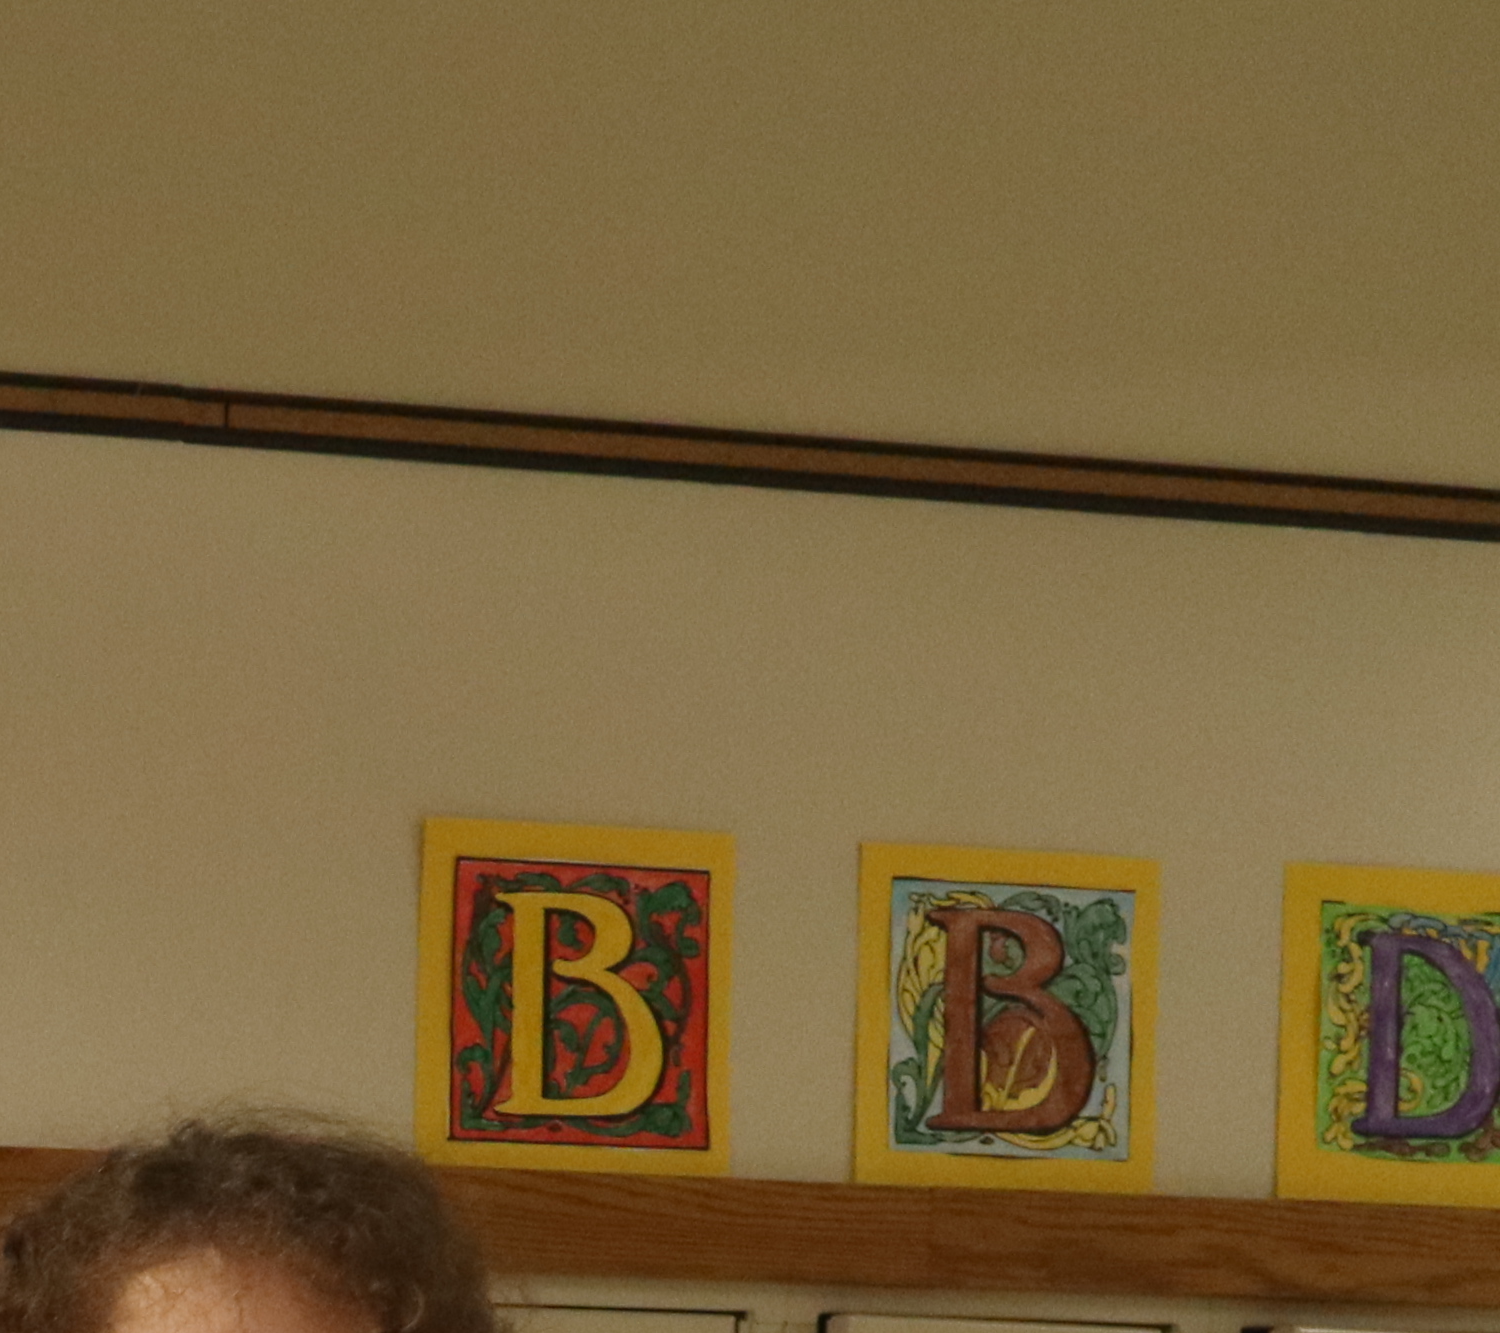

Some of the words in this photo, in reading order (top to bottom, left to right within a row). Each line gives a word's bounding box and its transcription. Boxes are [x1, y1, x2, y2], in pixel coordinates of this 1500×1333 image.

[492, 891, 669, 1120] B
[924, 904, 1097, 1136] B
[1351, 930, 1500, 1139] D
